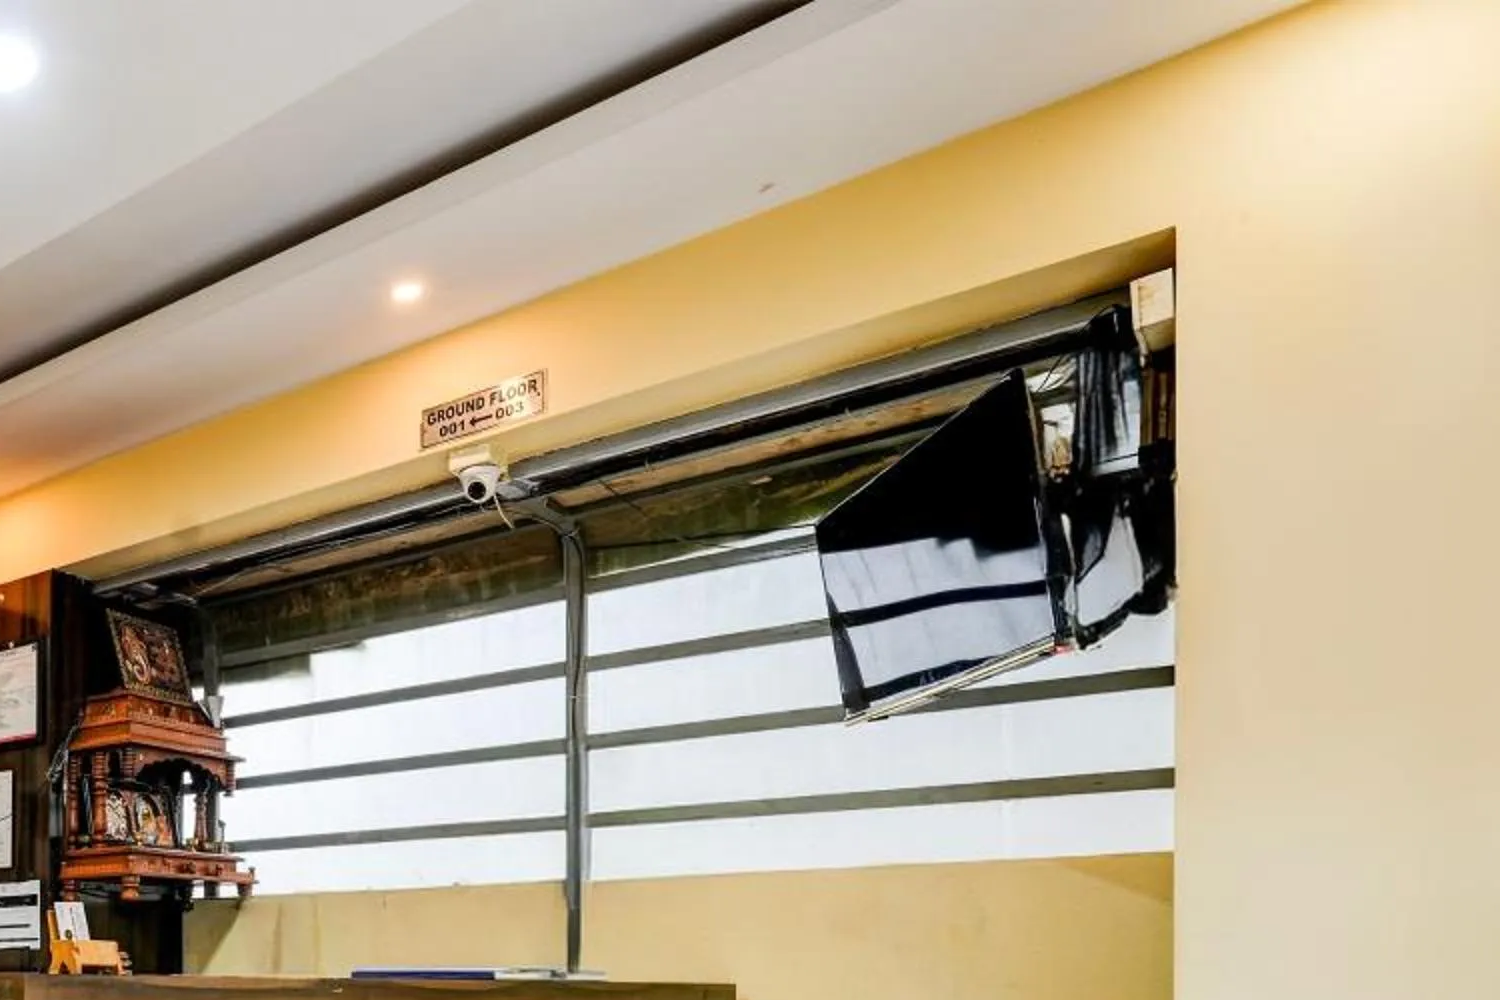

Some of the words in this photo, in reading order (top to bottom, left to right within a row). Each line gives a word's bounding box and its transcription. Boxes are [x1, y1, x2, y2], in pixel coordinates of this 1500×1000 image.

[427, 397, 485, 426] GROUND
[439, 420, 466, 438] 001
[495, 401, 525, 420] 003
